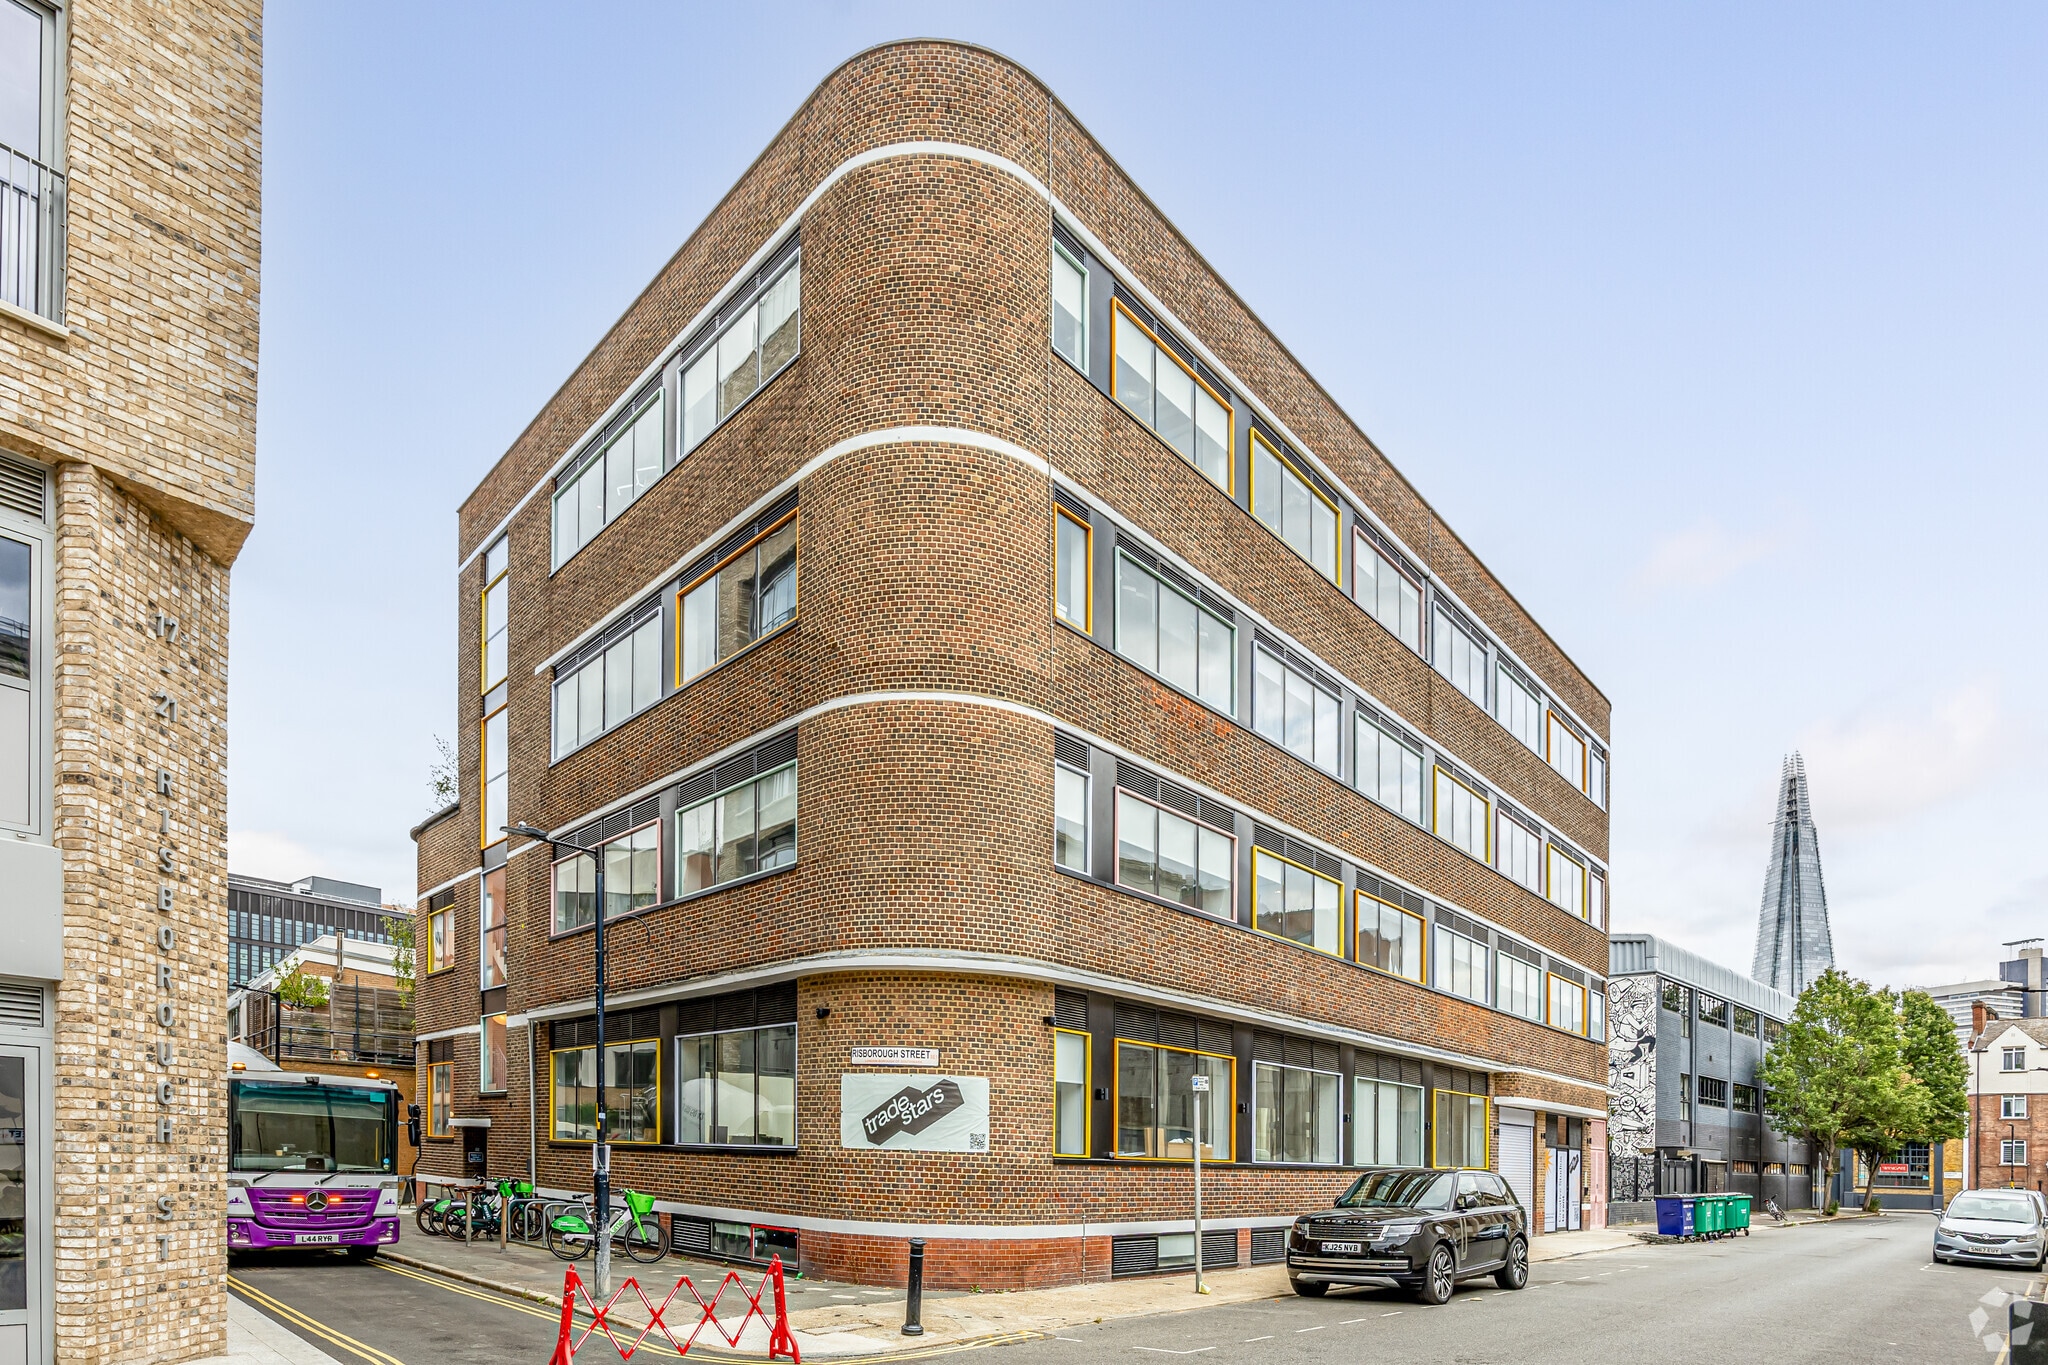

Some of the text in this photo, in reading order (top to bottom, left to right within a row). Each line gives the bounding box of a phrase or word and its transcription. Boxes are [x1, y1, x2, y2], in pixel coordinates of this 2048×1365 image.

[155, 611, 179, 642] 17
[155, 689, 178, 723] 21
[157, 767, 175, 1143] RISBOROUGH
[852, 1049, 899, 1058] RISBOROUGH
[900, 1050, 930, 1059] STREET
[865, 1096, 909, 1134] trade
[901, 1088, 945, 1125] stars
[156, 1196, 174, 1260] ST
[1344, 1244, 1359, 1252] NVB
